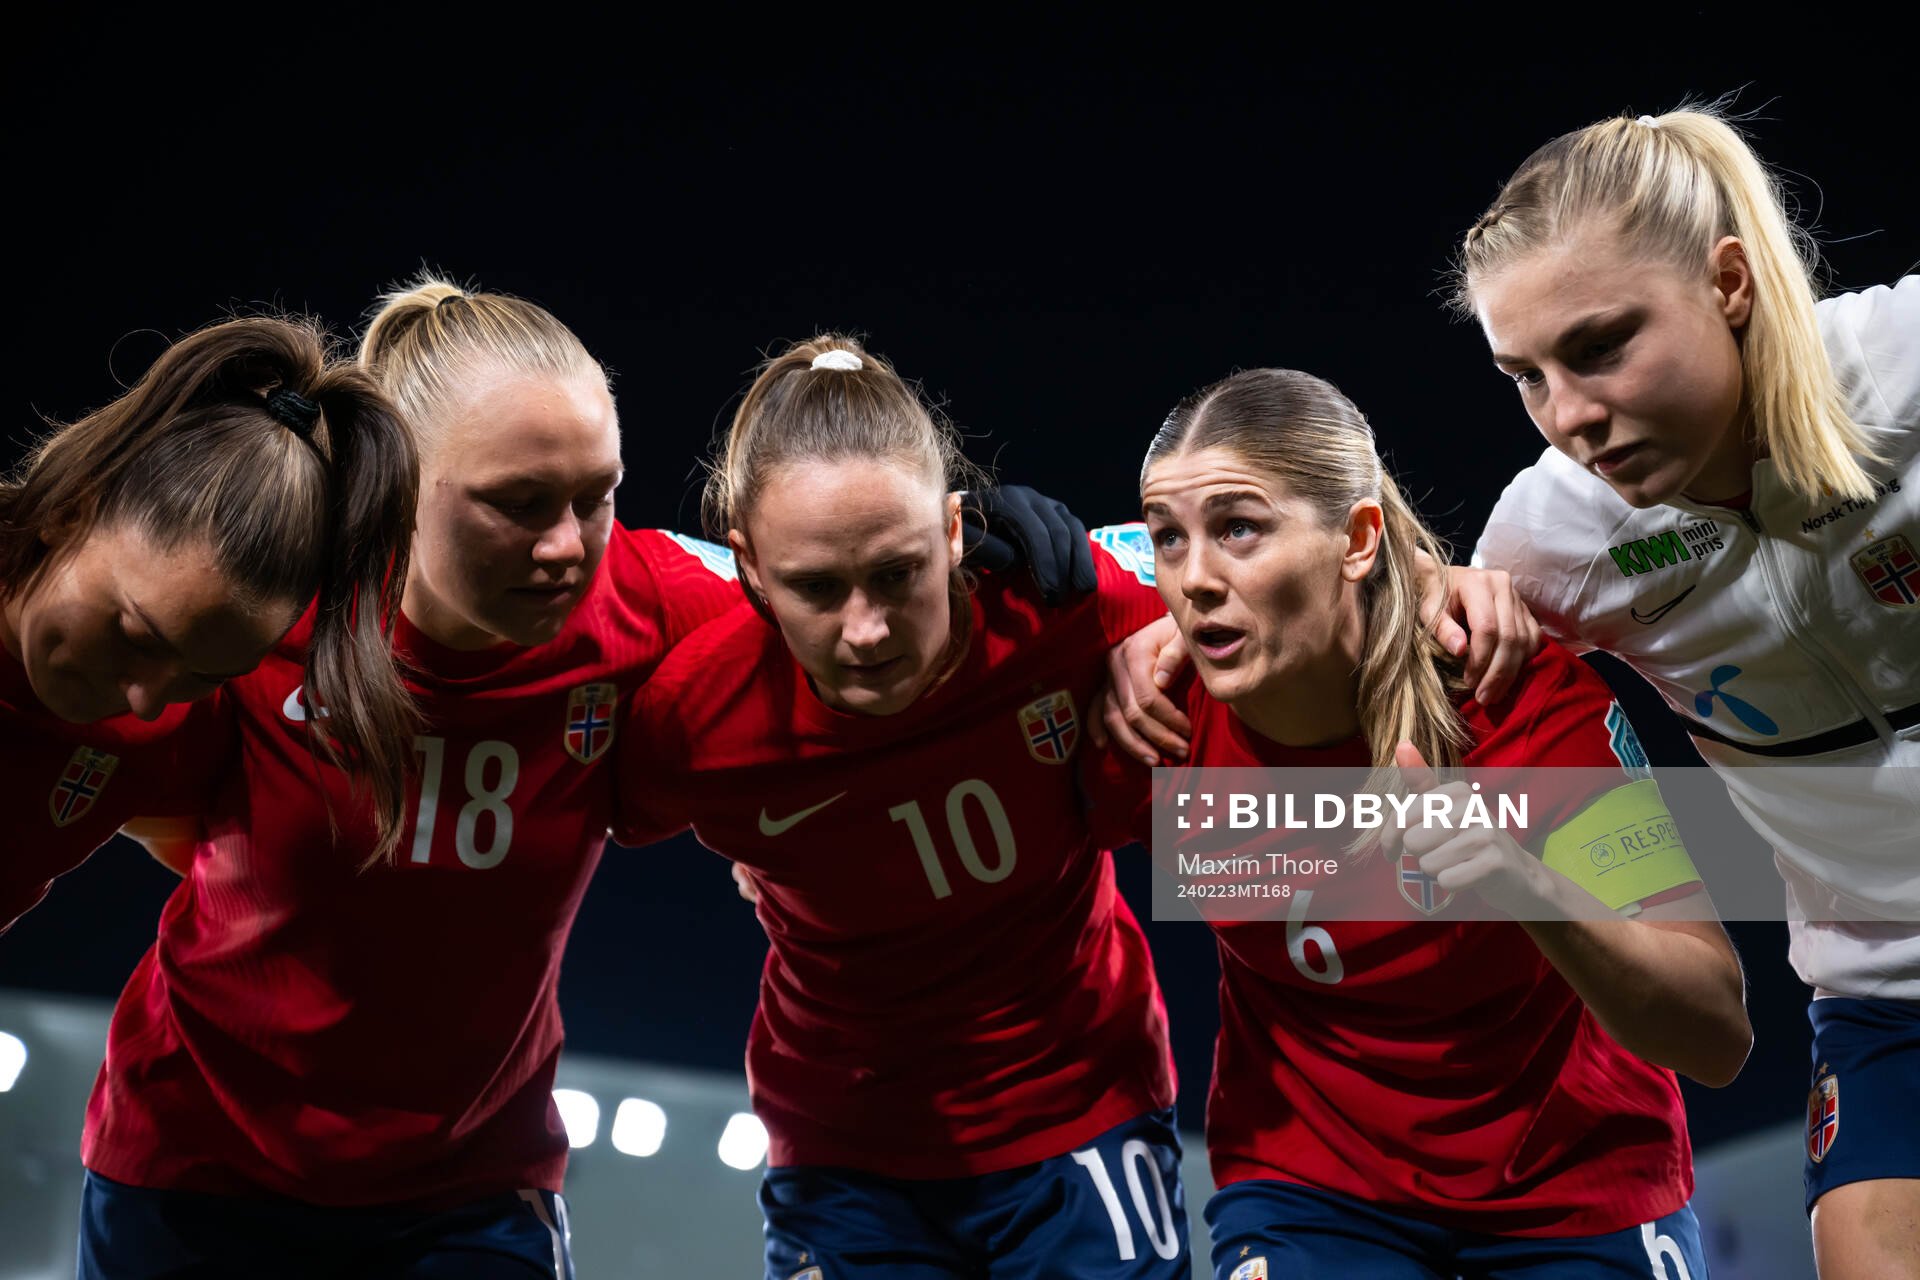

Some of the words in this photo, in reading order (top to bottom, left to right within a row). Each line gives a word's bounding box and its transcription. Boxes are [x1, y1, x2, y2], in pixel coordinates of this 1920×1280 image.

[1608, 530, 1692, 577] KIWI
[1682, 517, 1718, 542] mini
[1692, 537, 1724, 560] pris
[1801, 507, 1845, 533] Norsk
[411, 735, 519, 869] 18
[888, 778, 1017, 900] 10
[1285, 889, 1344, 985] 6
[1070, 1139, 1179, 1260] 10
